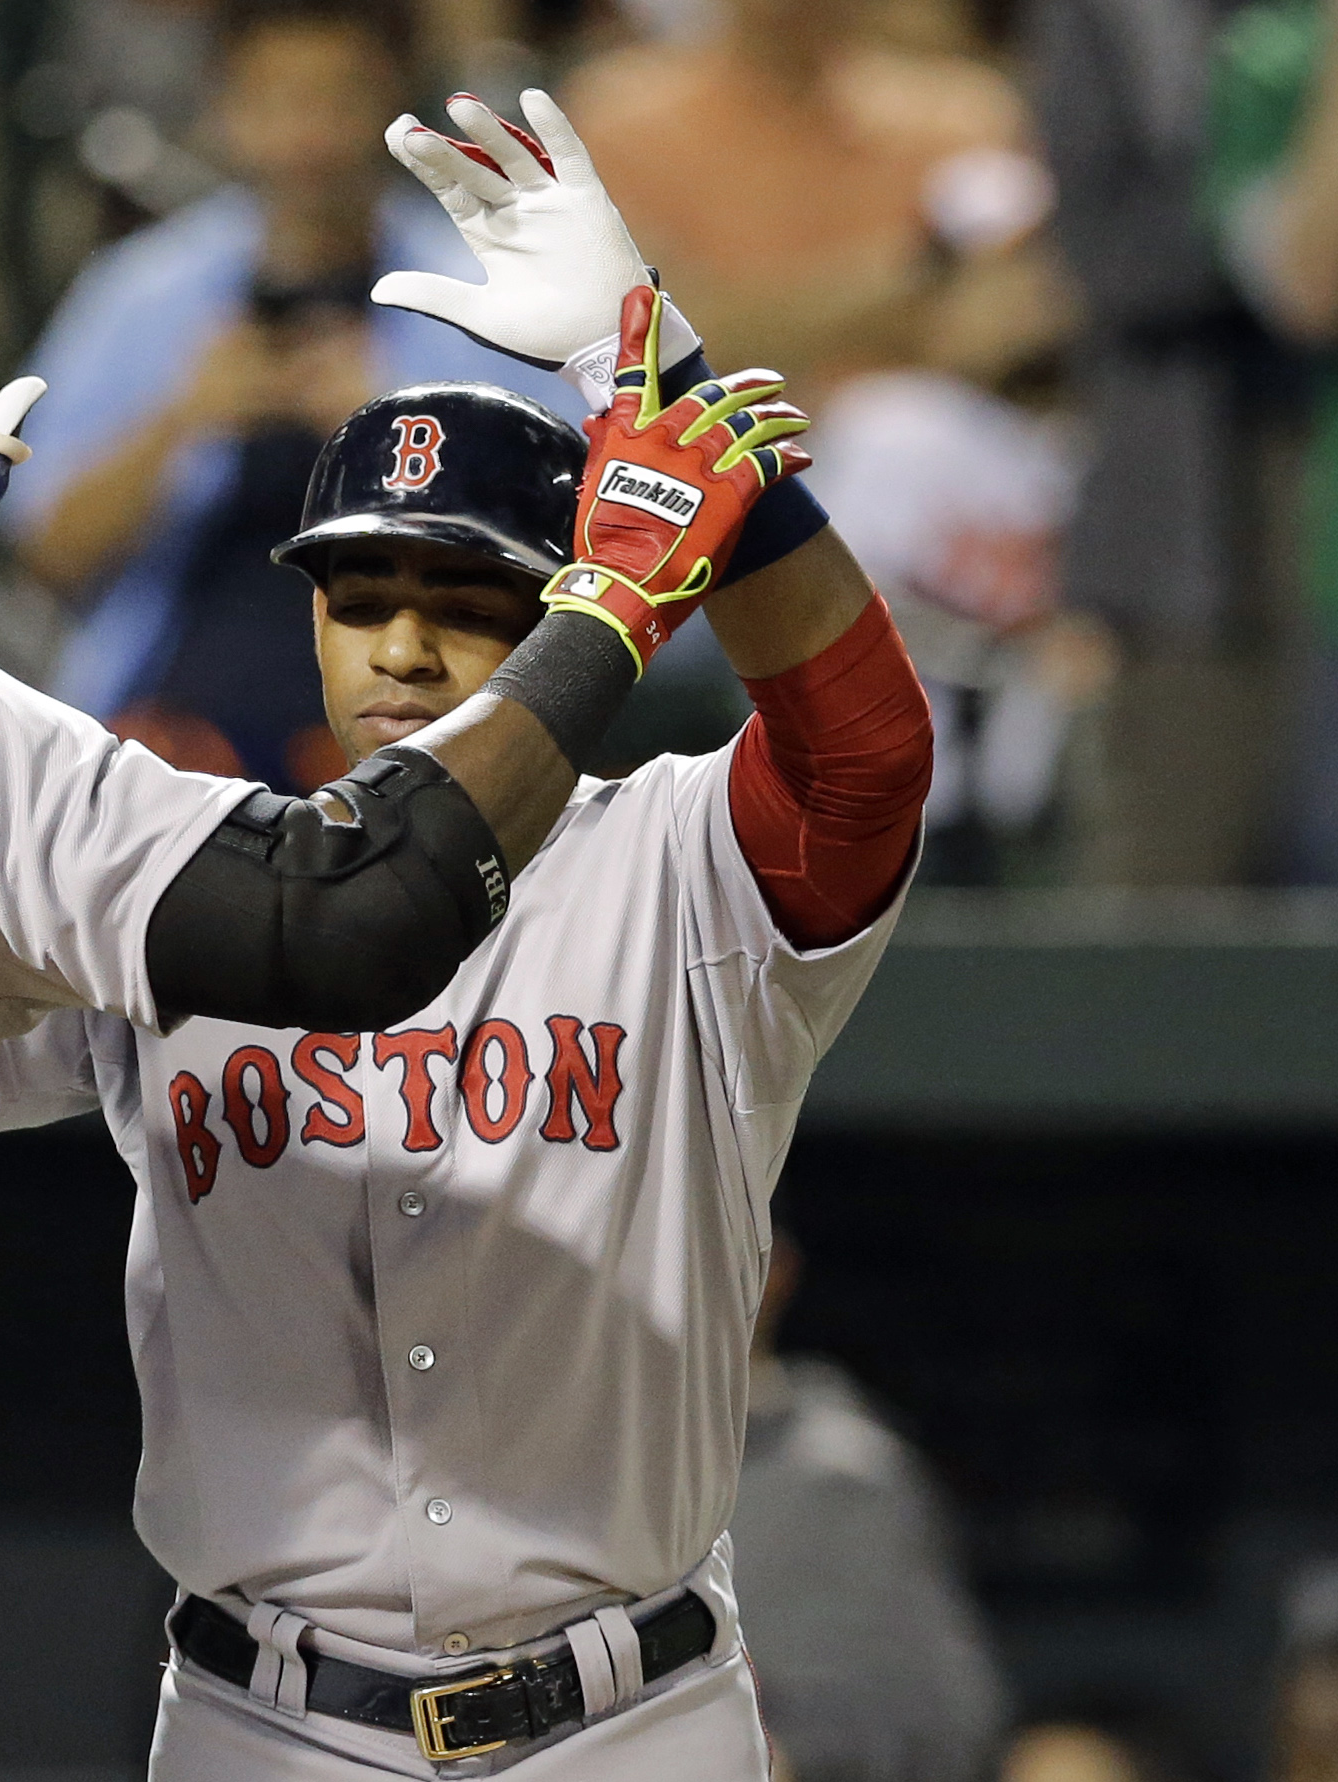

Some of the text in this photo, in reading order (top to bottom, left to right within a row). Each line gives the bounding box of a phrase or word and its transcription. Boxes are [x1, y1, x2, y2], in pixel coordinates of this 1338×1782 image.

[382, 415, 446, 491] B
[645, 620, 661, 645] 34
[475, 854, 507, 924] EBI
[168, 1014, 628, 1204] BOSTON
